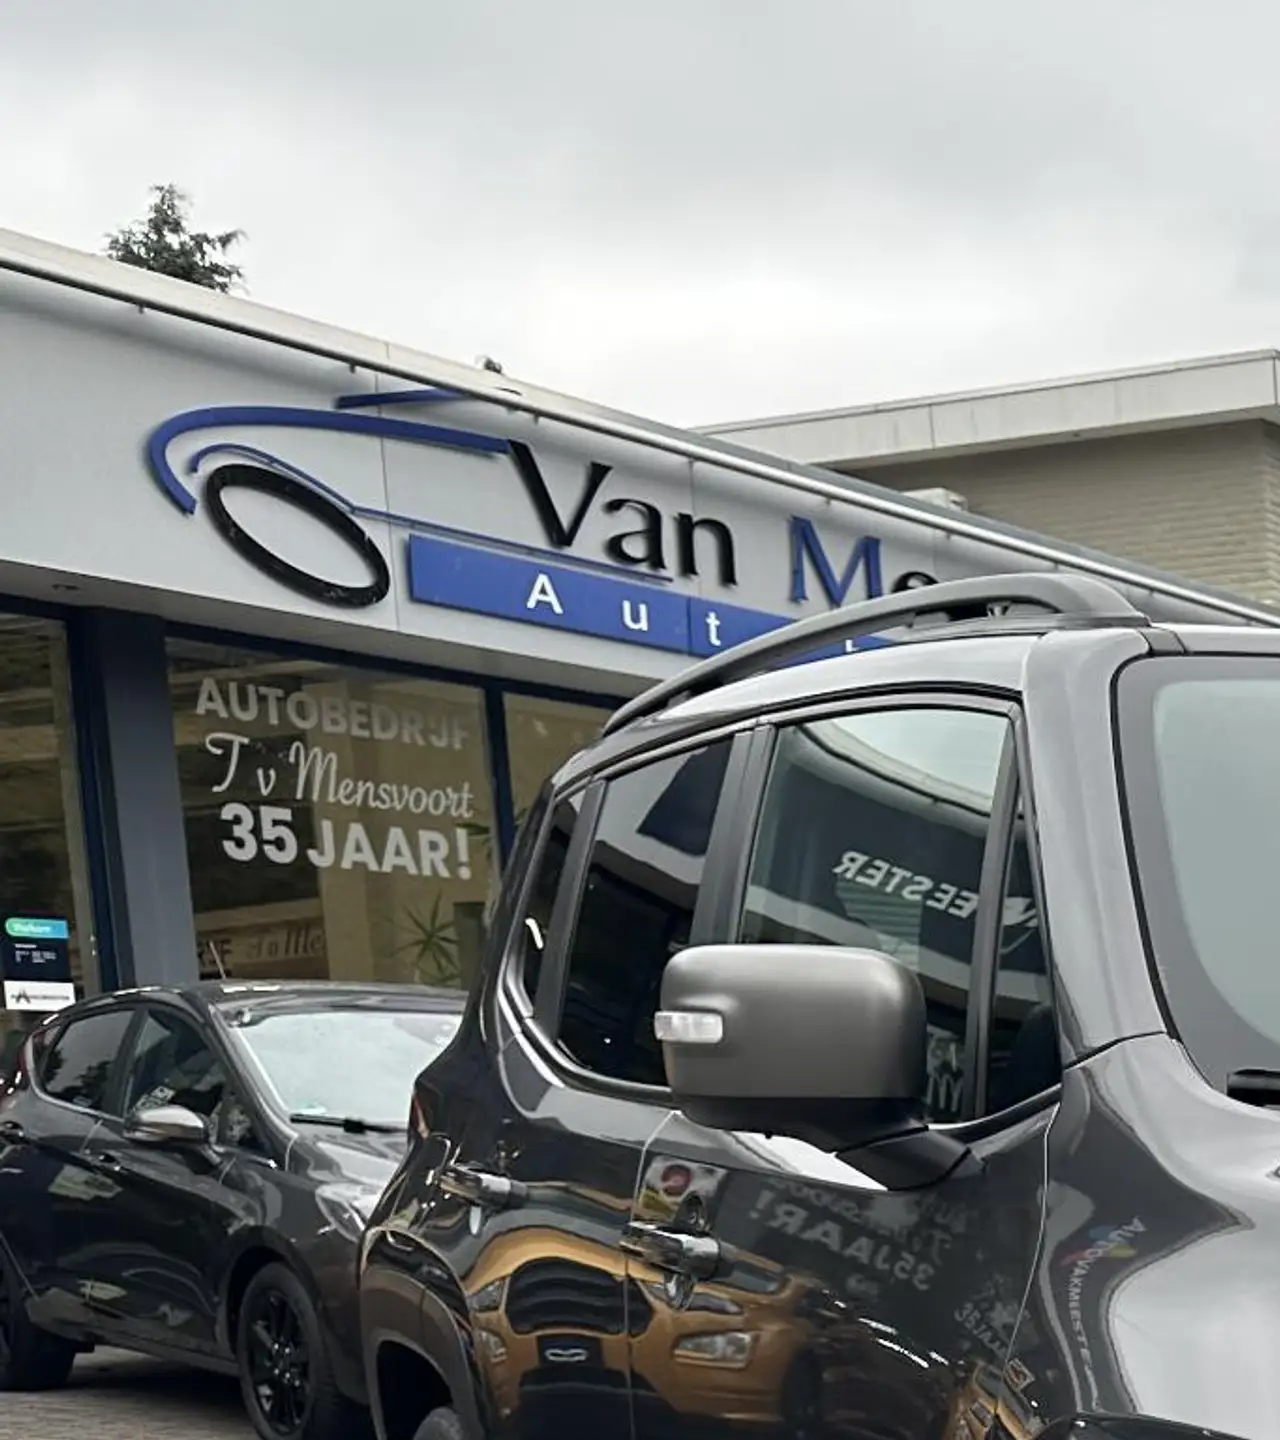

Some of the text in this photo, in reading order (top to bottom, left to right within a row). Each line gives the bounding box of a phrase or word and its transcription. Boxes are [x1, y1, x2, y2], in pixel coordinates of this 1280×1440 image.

[508, 439, 738, 587] Van
[196, 676, 472, 750] AUTOBEDRIJF
[257, 767, 276, 796] v
[289, 740, 474, 819] Mensvoort
[220, 802, 472, 880] 35 JAAR!
